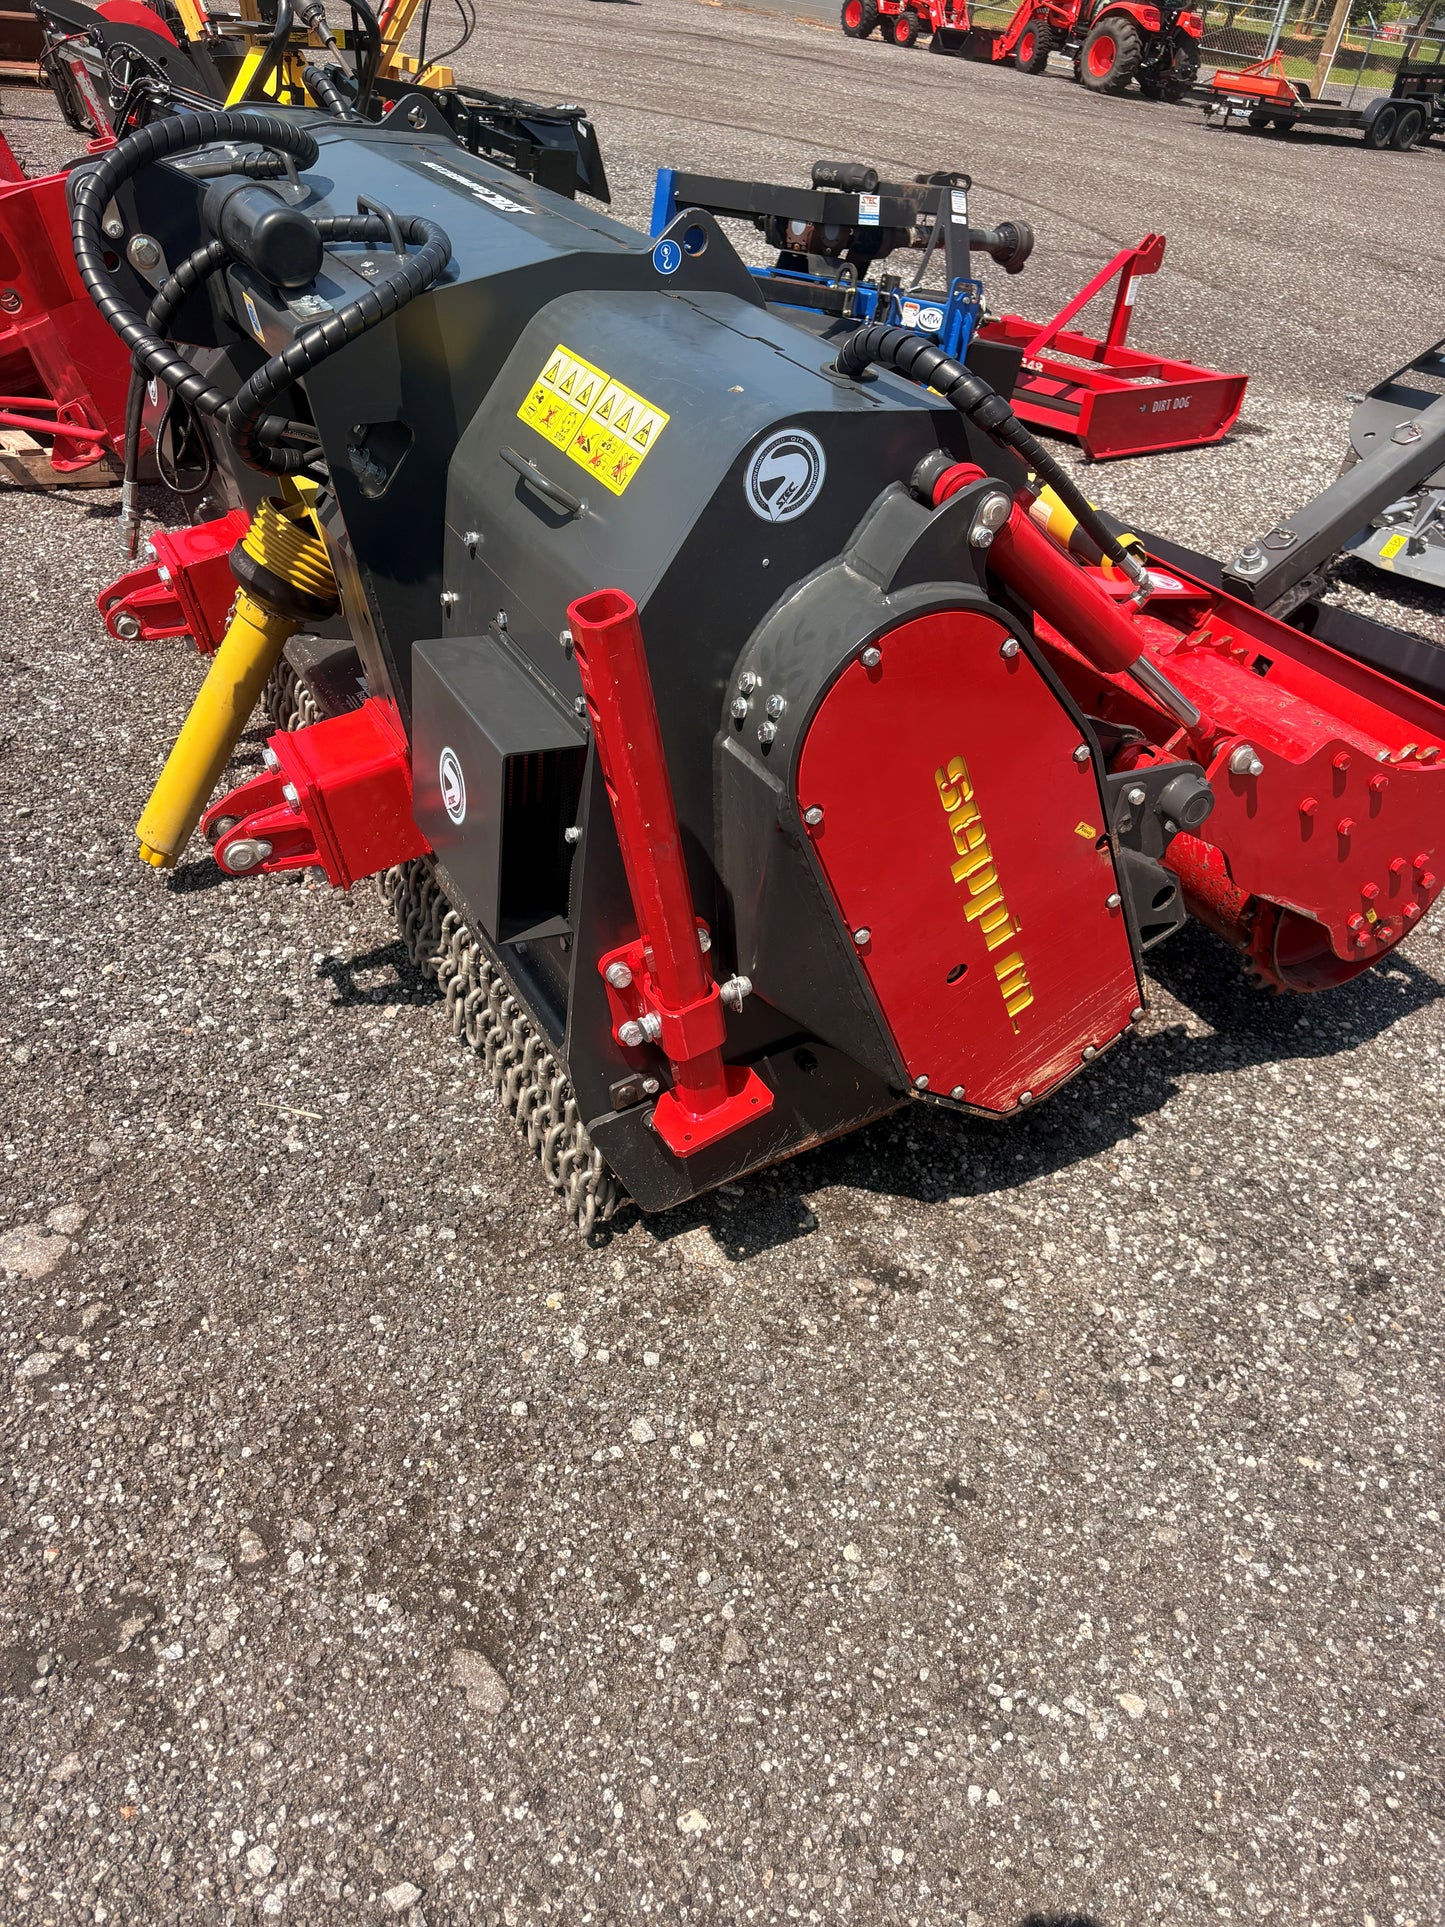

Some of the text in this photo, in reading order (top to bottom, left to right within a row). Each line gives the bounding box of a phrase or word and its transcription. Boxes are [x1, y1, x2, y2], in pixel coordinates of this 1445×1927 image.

[861, 195, 877, 205] STEC
[1151, 396, 1190, 413] DIRT DOG
[776, 481, 799, 510] STEC
[935, 755, 1022, 952] seppi
